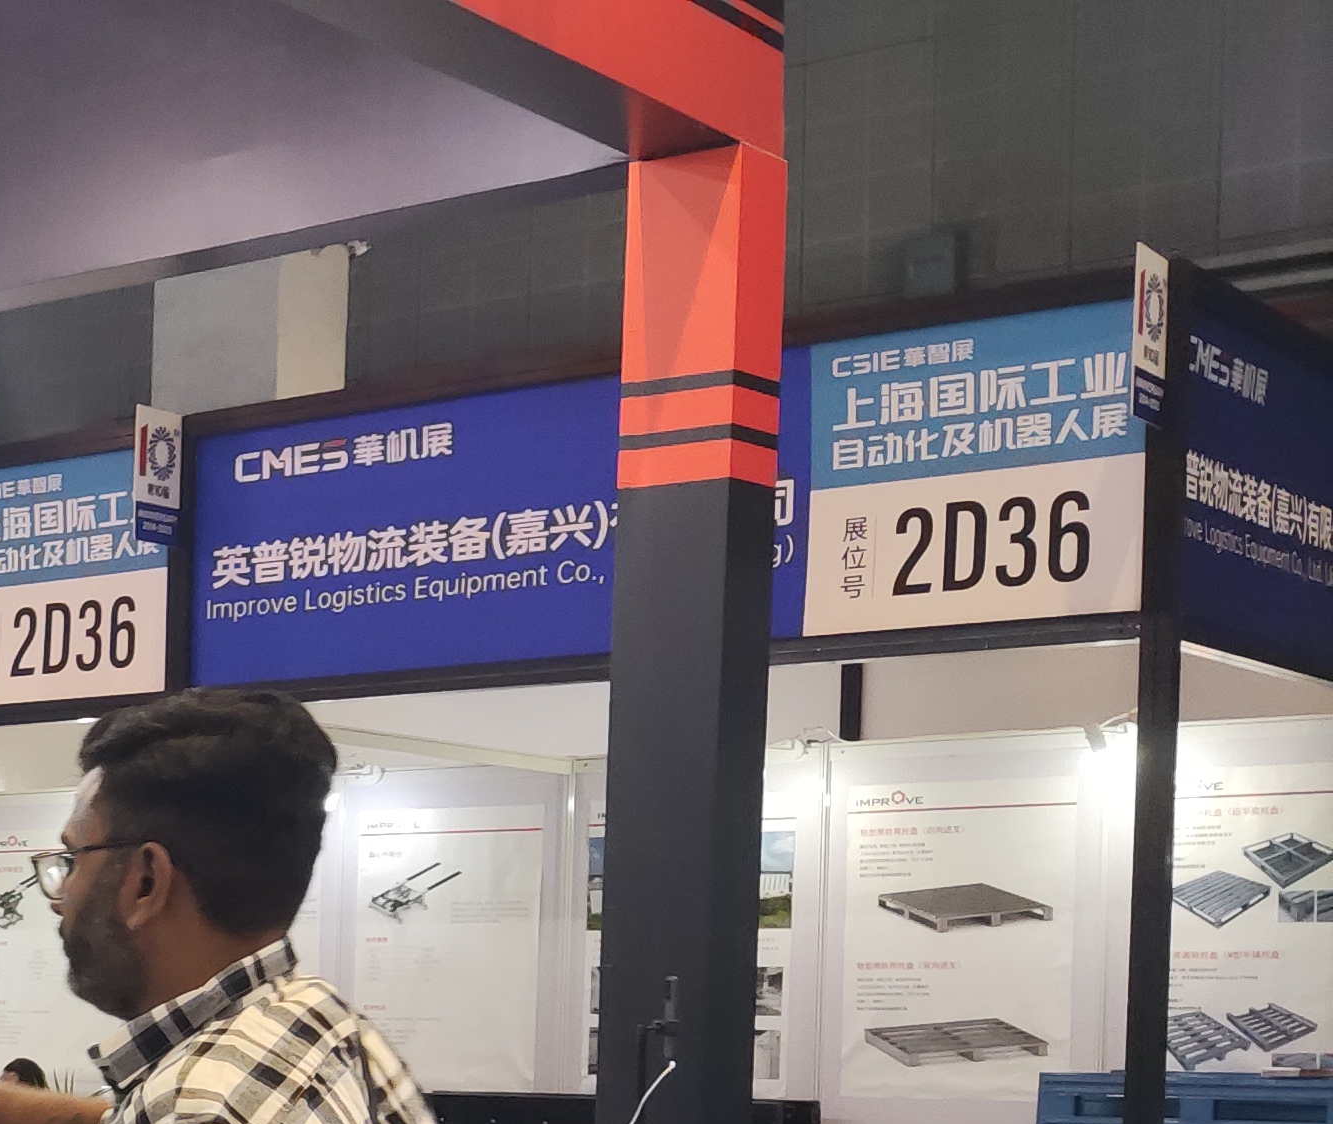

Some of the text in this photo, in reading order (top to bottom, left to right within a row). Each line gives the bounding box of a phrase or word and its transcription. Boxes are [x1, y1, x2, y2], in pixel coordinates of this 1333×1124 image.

[832, 350, 901, 378] CSIE
[833, 352, 1128, 431] 上海国际工业
[235, 439, 348, 483] CMES
[833, 402, 1128, 470] 自动化及机器人展
[212, 501, 620, 589] 英普锐物流装备(嘉兴)
[840, 516, 868, 599] 展位号
[892, 490, 1090, 597] 2D36
[206, 592, 297, 623] Improve
[304, 580, 406, 613] Logistics
[414, 564, 547, 600] Equipment
[556, 560, 605, 586] Co.,
[10, 596, 135, 677] 2D36
